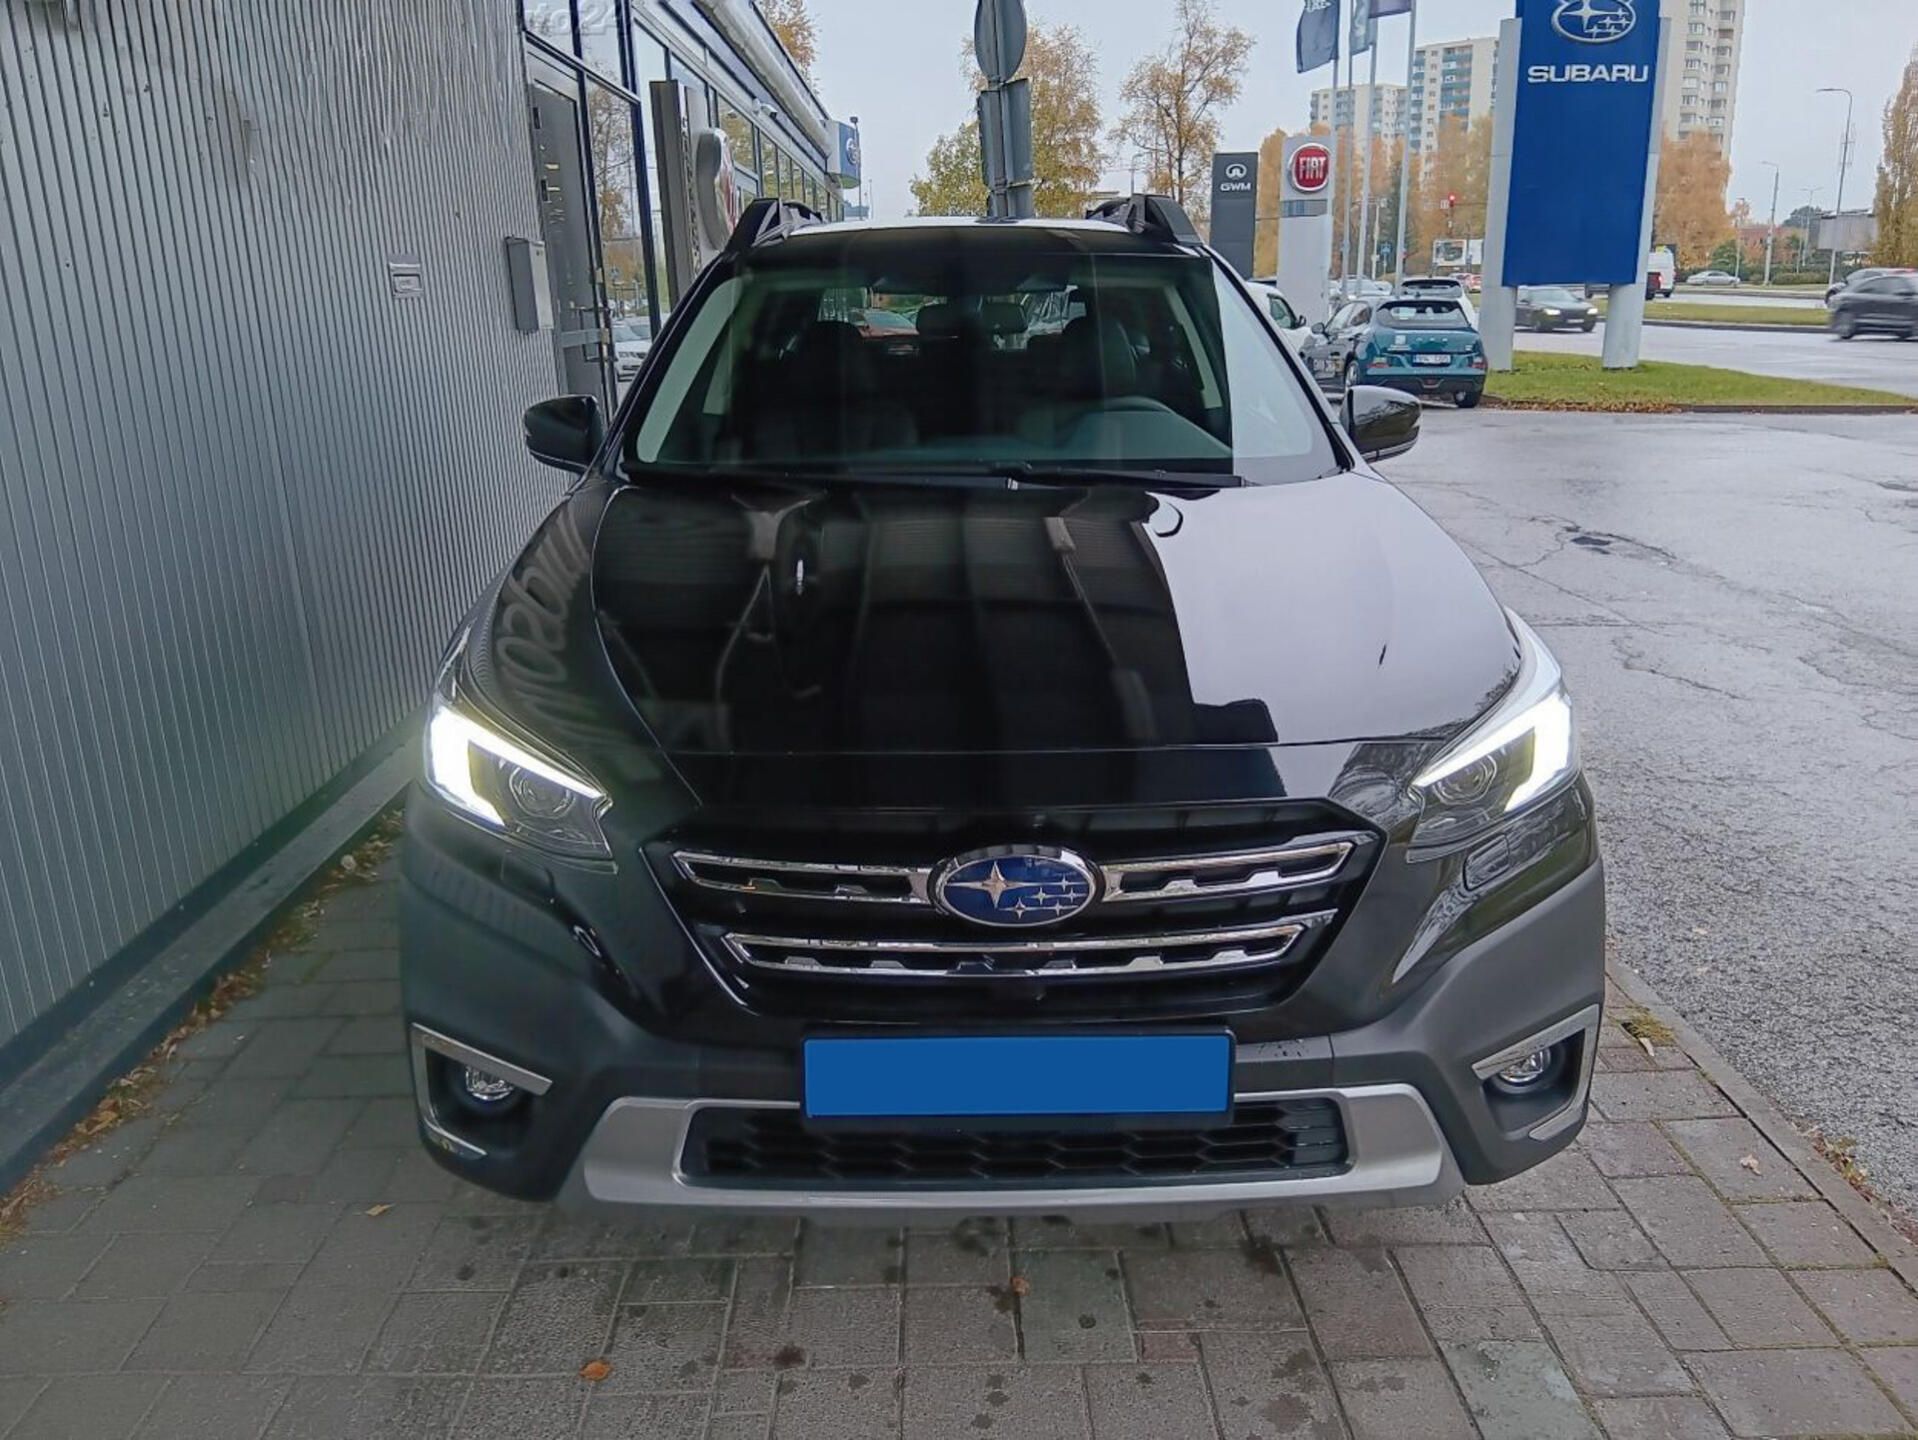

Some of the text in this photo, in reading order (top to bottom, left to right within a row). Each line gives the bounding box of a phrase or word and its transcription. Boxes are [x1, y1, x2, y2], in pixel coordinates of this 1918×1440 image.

[1527, 64, 1649, 83] SUBARU
[1299, 156, 1327, 180] FIAT
[1220, 182, 1252, 191] GWM
